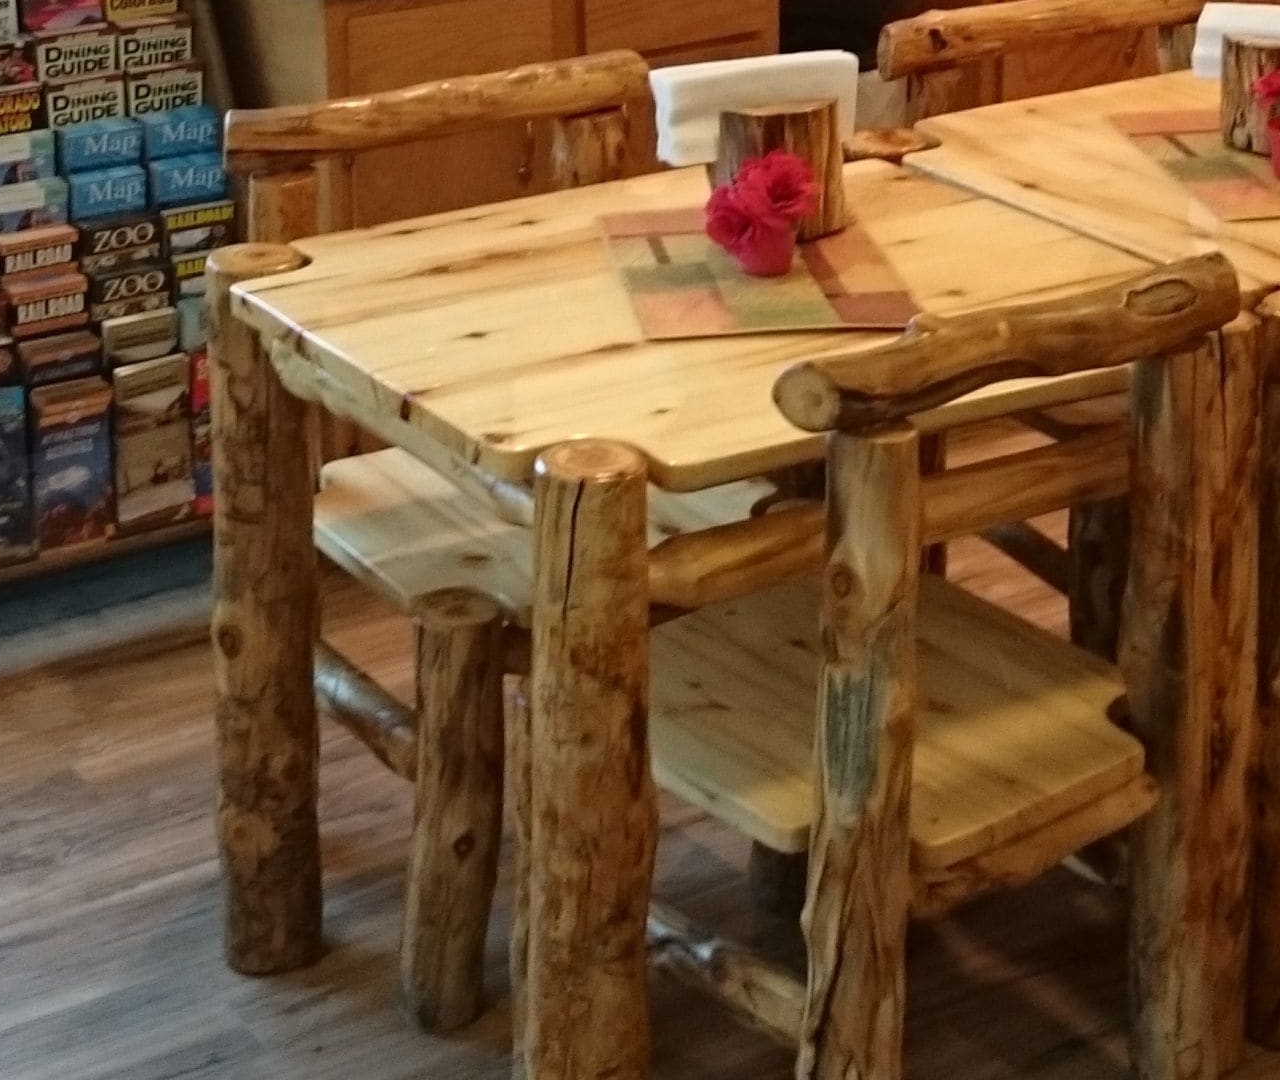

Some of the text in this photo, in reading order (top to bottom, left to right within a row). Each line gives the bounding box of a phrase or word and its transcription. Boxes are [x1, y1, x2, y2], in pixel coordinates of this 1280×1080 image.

[45, 43, 111, 64] DINING
[124, 37, 188, 55] DINING
[45, 56, 110, 78] GUIDE
[124, 49, 187, 69] GUIDE
[53, 90, 119, 112] DINING
[134, 80, 199, 101] DINING
[134, 92, 198, 114] GUIDE
[53, 103, 119, 126] GUIDE
[162, 120, 213, 144] Map
[84, 133, 137, 156] Map
[172, 166, 224, 188] Map
[88, 180, 141, 203] Map
[94, 222, 155, 253] ZOO
[5, 242, 72, 274] RAILROAD
[103, 270, 165, 302] ZOO
[17, 293, 84, 325] RAILROAD
